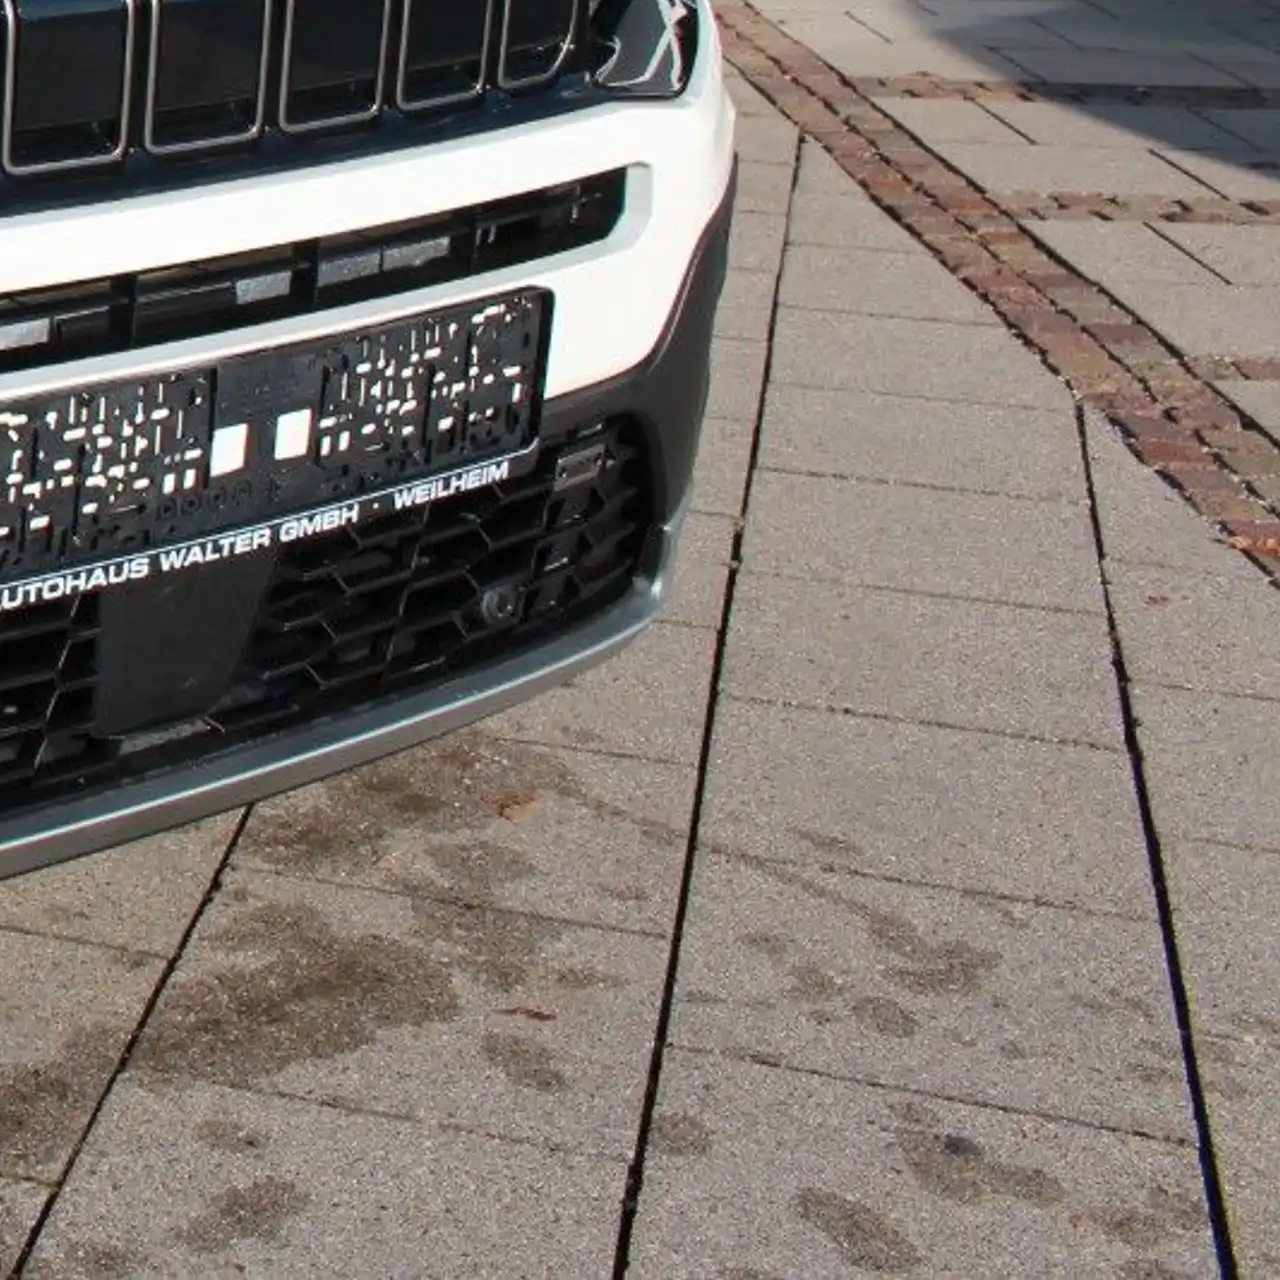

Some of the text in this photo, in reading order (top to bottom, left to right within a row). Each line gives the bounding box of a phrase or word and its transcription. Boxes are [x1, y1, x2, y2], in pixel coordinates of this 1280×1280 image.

[159, 527, 272, 573] WALTER
[278, 503, 360, 543] GMBH
[393, 460, 509, 510] WEILHEIM
